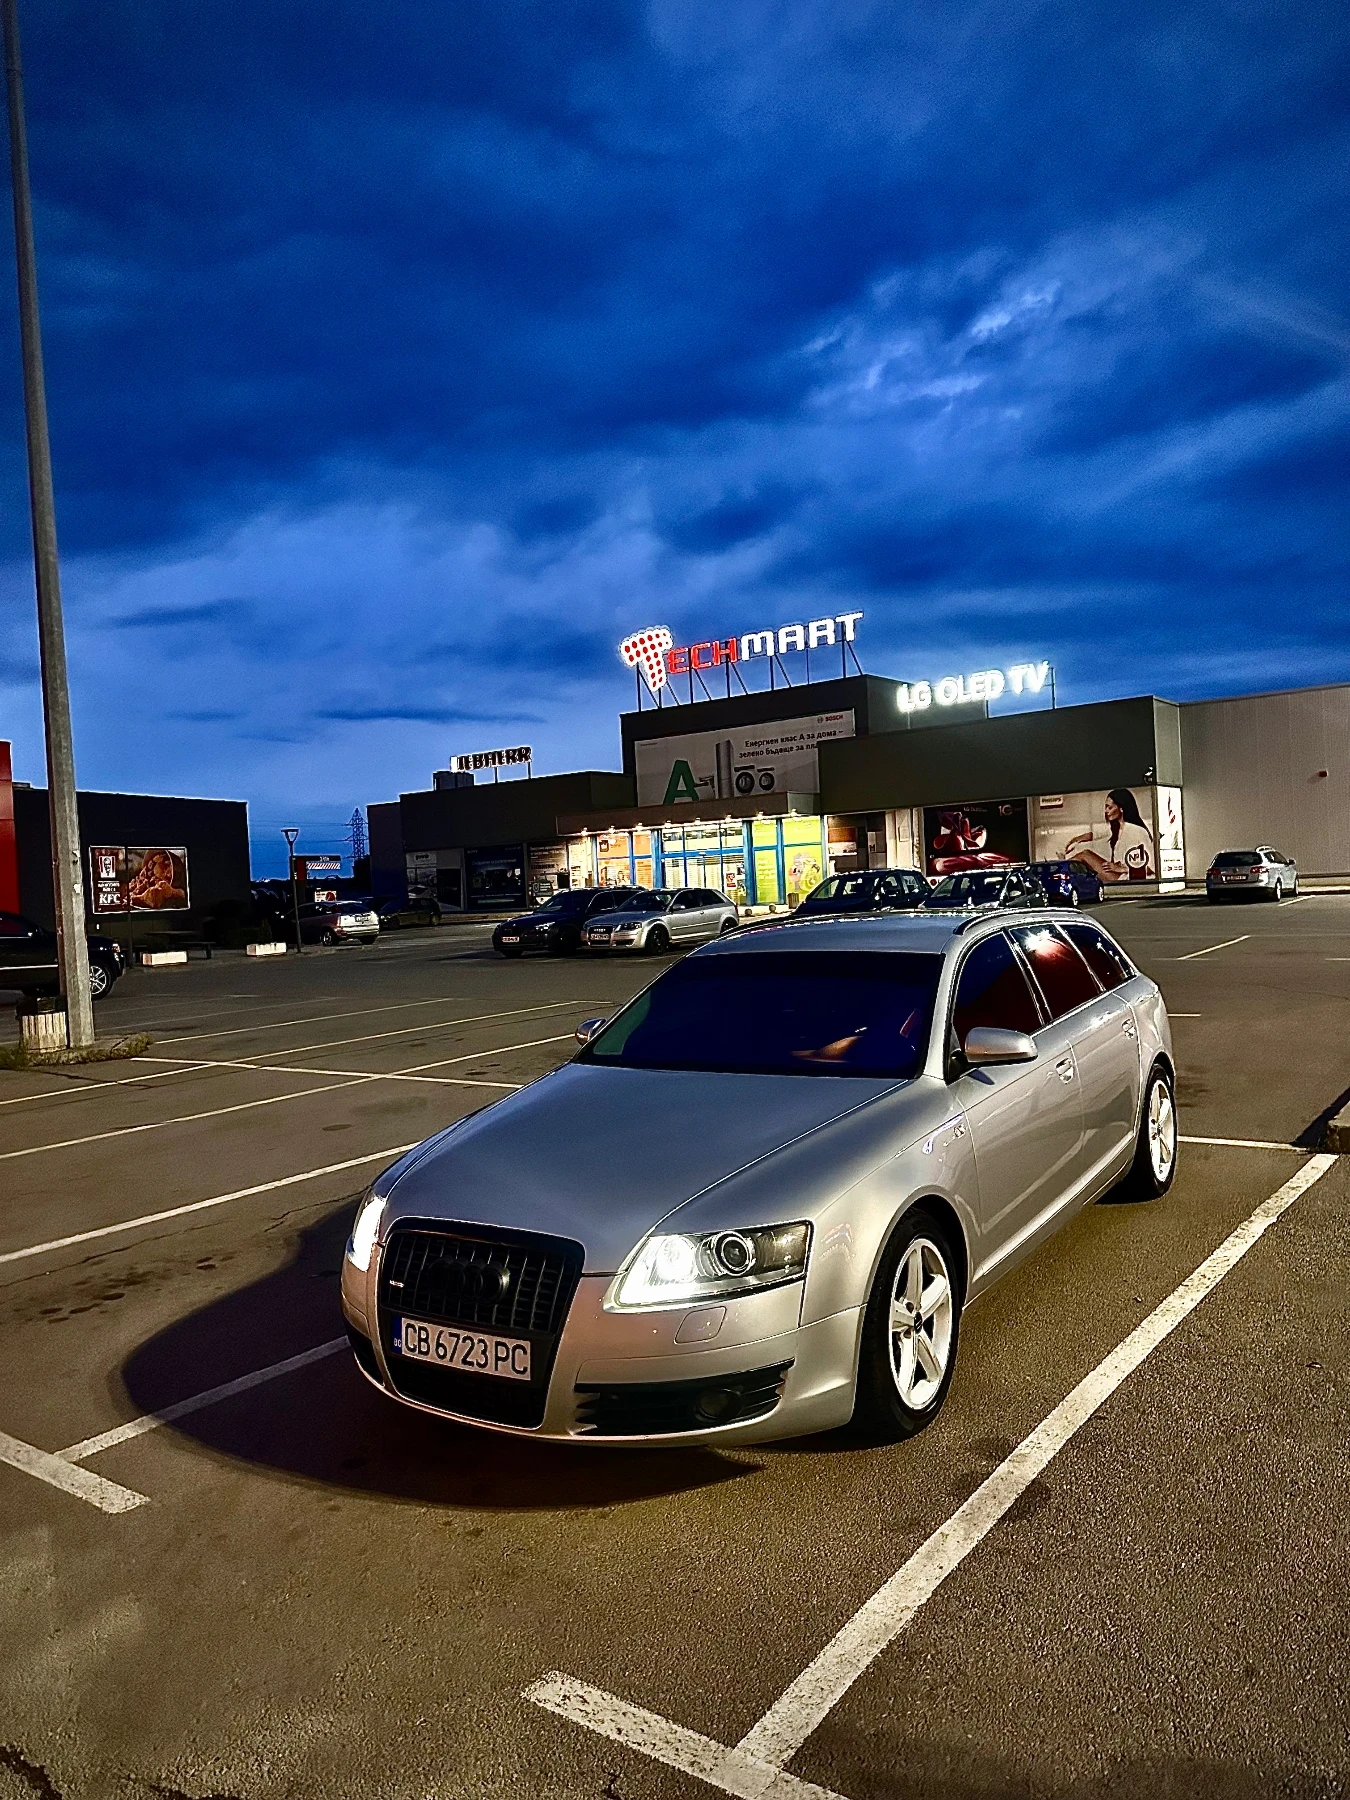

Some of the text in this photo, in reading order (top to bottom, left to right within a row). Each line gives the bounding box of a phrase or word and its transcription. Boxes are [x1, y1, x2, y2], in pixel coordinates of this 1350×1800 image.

[619, 611, 864, 691] TECHMART
[897, 660, 1049, 712] LG OLED TV
[825, 714, 844, 722] BOSCH
[745, 738, 779, 748] Енергиен
[780, 735, 797, 744] клас
[817, 730, 837, 740] дома
[738, 749, 764, 759] зелено
[98, 893, 121, 904] KFC
[404, 1322, 528, 1375] CB 6723 PC
